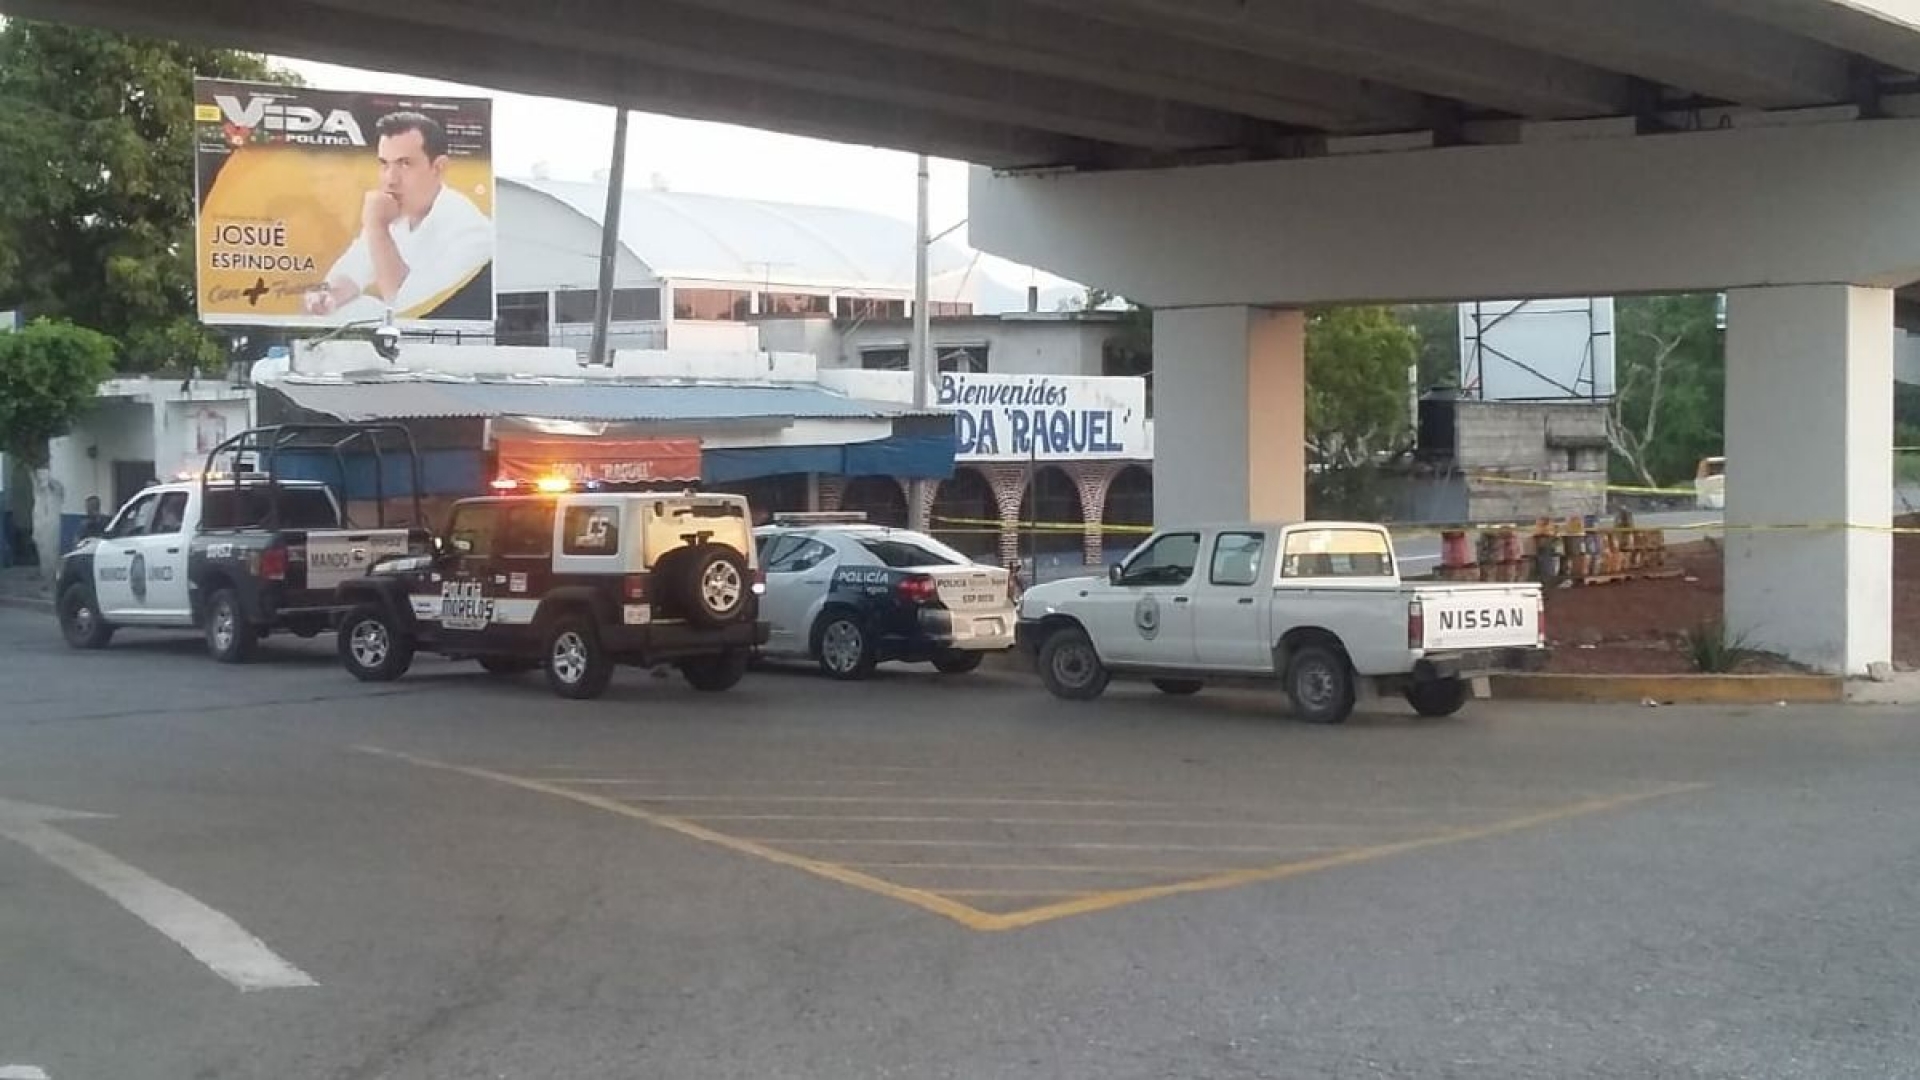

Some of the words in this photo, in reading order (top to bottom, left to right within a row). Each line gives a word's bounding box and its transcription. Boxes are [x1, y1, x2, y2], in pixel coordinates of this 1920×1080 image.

[212, 221, 285, 247] JOSUÉ
[212, 252, 315, 271] ESPINDOLA
[937, 375, 1068, 406] Bienvenidos
[1440, 608, 1523, 629] NISSAN
